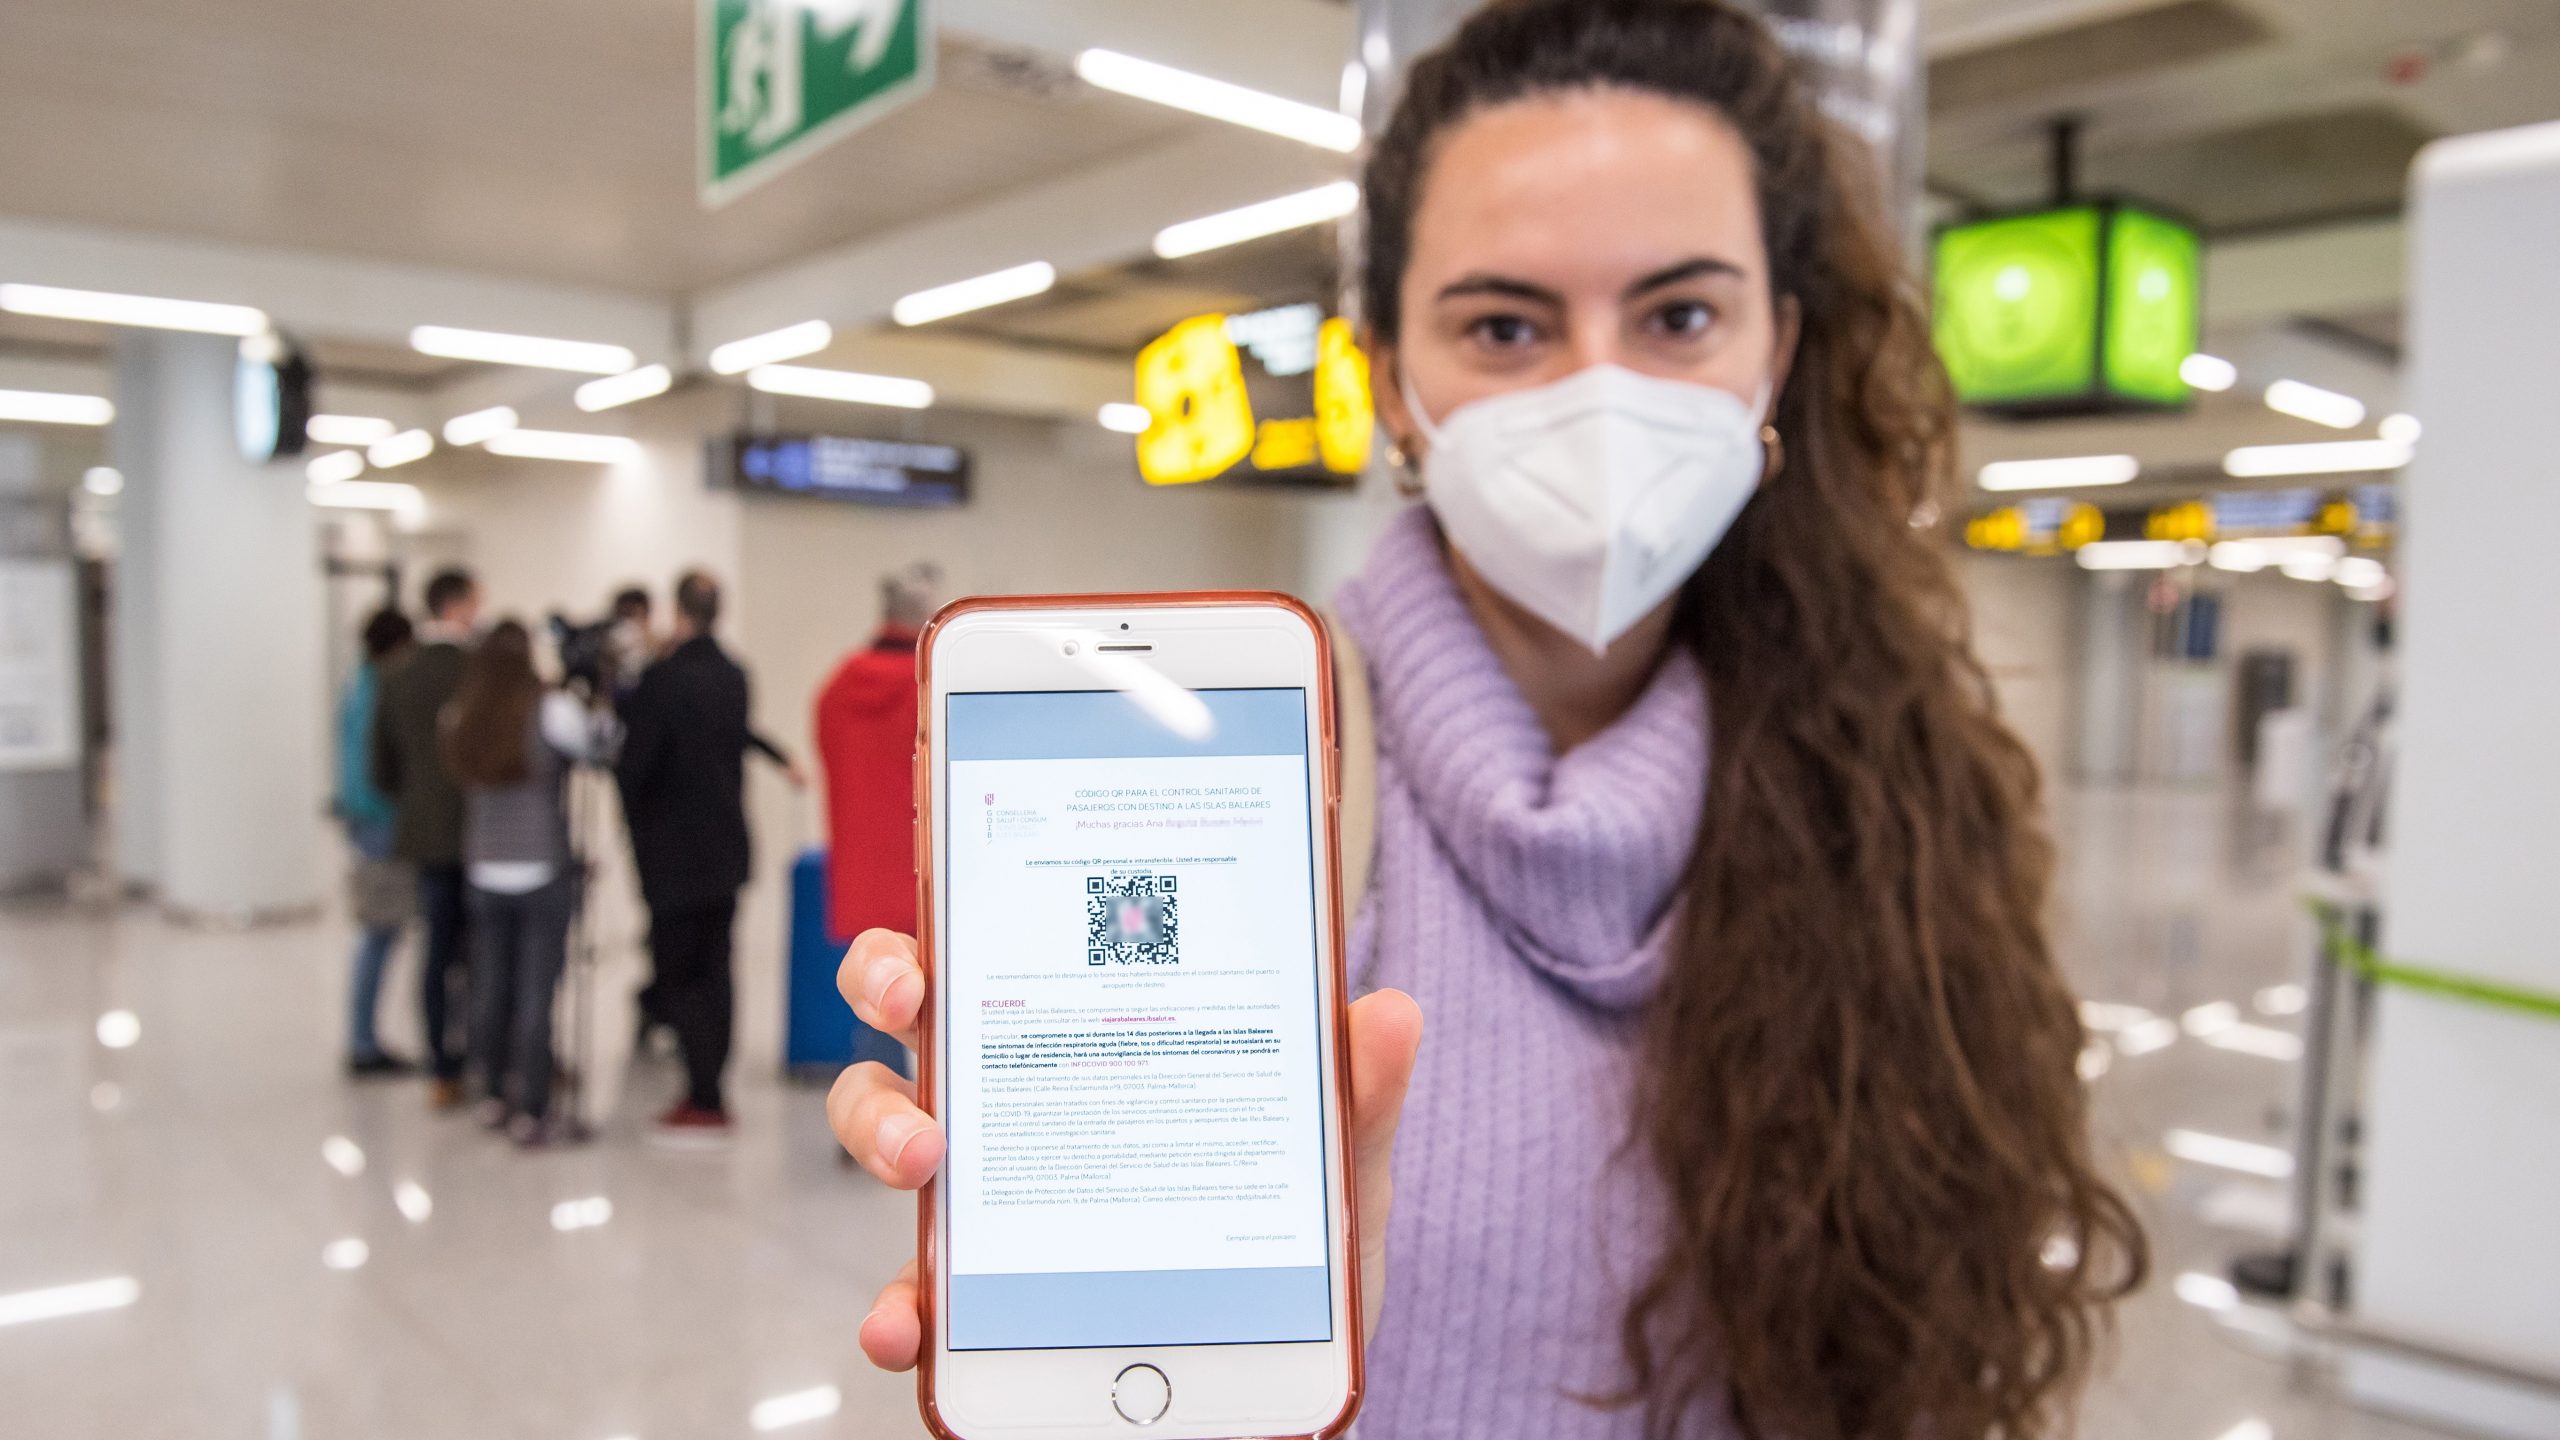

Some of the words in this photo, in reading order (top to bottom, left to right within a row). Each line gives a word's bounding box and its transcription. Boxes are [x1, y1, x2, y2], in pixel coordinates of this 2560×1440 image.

[1075, 789, 1109, 798] CÓDIGO
[1111, 789, 1124, 798] QR
[1125, 789, 1148, 797] PARA
[1149, 789, 1159, 797] EL
[1162, 788, 1202, 796] CONTROL
[1204, 787, 1249, 796] SANITARIO
[1251, 787, 1262, 795] DE
[1066, 803, 1116, 812] PASAJEROS
[1117, 803, 1137, 811] CON
[1138, 802, 1175, 811] DESTINO
[1177, 802, 1183, 810] A
[1185, 802, 1201, 810] LAS
[1203, 801, 1227, 810] ISLAS
[1228, 800, 1271, 809] BALEARES
[1113, 819, 1144, 830] gracias
[1146, 819, 1164, 828] Ana
[1092, 858, 1102, 866] QR
[1102, 858, 1128, 866] personal
[1202, 856, 1237, 864] responsable
[981, 999, 1026, 1008] RECUERDE
[1028, 1032, 1067, 1040] compromete
[1148, 1030, 1182, 1038] posteriores
[1195, 1029, 1217, 1037] llegada
[1063, 1041, 1097, 1049] respiratoria
[1118, 1040, 1139, 1048] (fiebre,
[1186, 1039, 1222, 1047] respiratoria)
[1101, 1050, 1141, 1058] autovigilancia
[981, 1062, 1008, 1070] contacto
[1070, 1060, 1108, 1068] INFOCOVID
[988, 1076, 1025, 1084] responsable
[1110, 1073, 1141, 1082] personales
[1222, 1071, 1246, 1079] Servicio
[1060, 1173, 1080, 1181] Palma
